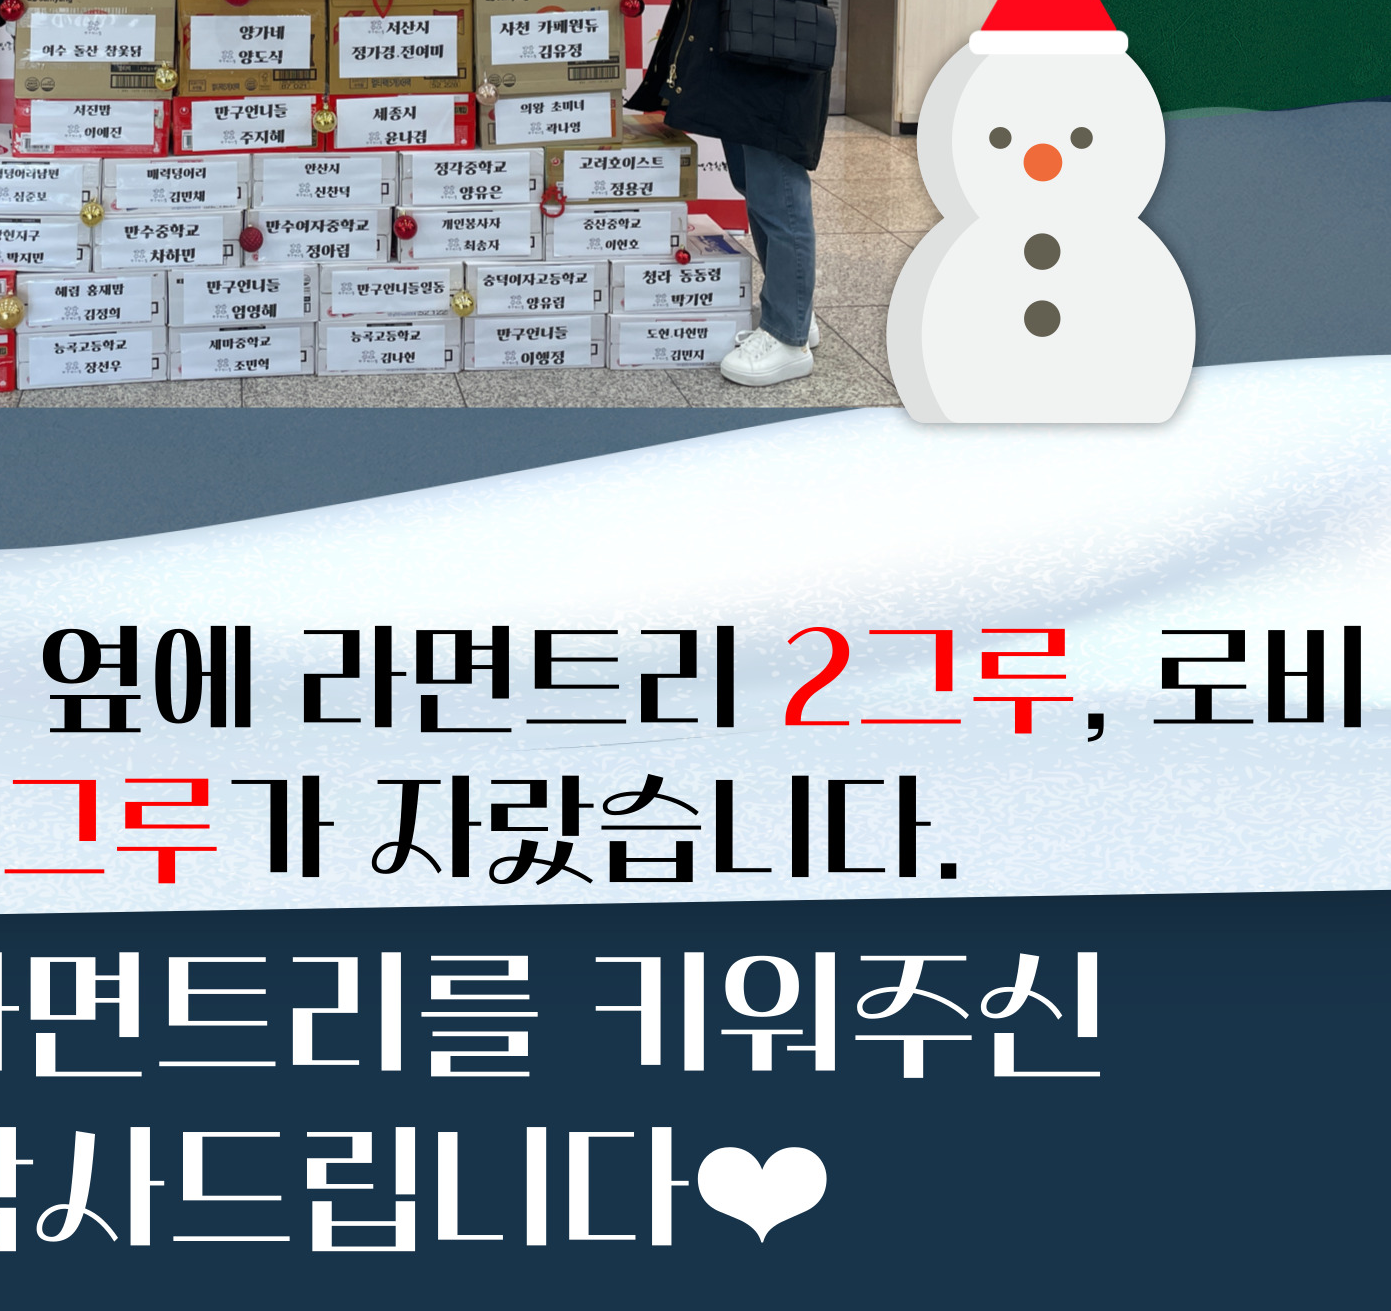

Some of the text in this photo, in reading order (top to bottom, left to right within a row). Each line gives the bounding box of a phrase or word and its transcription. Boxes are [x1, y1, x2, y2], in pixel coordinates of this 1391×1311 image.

[239, 25, 285, 40] 양가네
[387, 20, 430, 35] 서산시
[500, 18, 597, 36] 사천 카페원듀
[42, 44, 67, 57] 여수
[238, 49, 283, 65] 양도식
[539, 43, 583, 60] 김유정
[74, 104, 111, 116] 서진맘
[214, 103, 287, 121] 만구언니들
[373, 105, 417, 122] 세종시
[520, 99, 585, 115] 의왕 초미녀
[240, 128, 285, 145] 주지혜
[304, 162, 340, 175] 안산시
[434, 160, 507, 176] 정각중학교
[580, 156, 664, 171] 고려호이스트
[146, 167, 207, 180] 매력덩어리
[170, 190, 206, 203] 김민채
[459, 185, 502, 201] 양유은
[610, 181, 654, 197] 정용권
[124, 223, 199, 240] 만수중학교
[265, 218, 369, 234] 만수여자중학교
[442, 217, 501, 230] 개인봉사자
[306, 243, 350, 259] 정아림
[464, 239, 500, 252] 최송자
[150, 247, 196, 264] 차하민
[642, 269, 671, 285] 청라
[206, 278, 280, 295] 만구언니들
[357, 281, 444, 296] 만구언니들일동
[526, 296, 565, 310] 양유림
[84, 307, 121, 321] 김정희
[231, 303, 277, 320] 엄영혜
[496, 326, 568, 342] 만구언니들
[381, 351, 416, 364] 김나현
[671, 349, 705, 362] 김민지
[85, 360, 121, 374] 장선우
[235, 357, 270, 372] 조민혁
